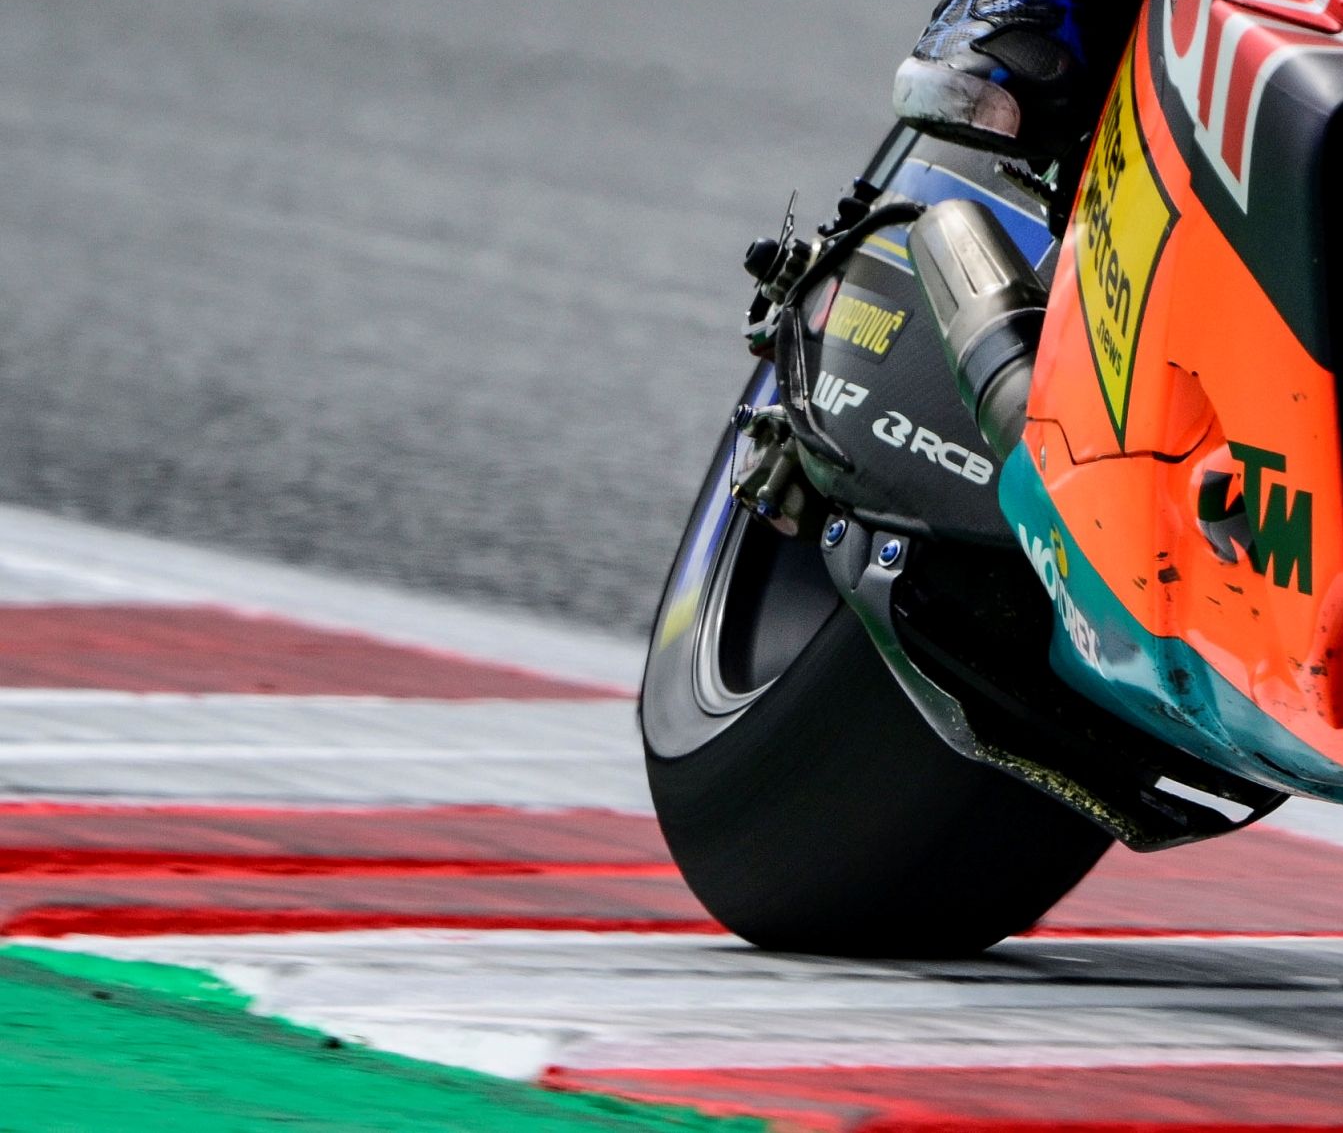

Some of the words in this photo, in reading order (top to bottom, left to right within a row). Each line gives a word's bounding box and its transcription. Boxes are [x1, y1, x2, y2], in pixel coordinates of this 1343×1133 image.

[1083, 153, 1133, 339] wetten
[811, 370, 870, 416] WP
[909, 426, 994, 485] RCB
[1198, 440, 1313, 596] KTM
